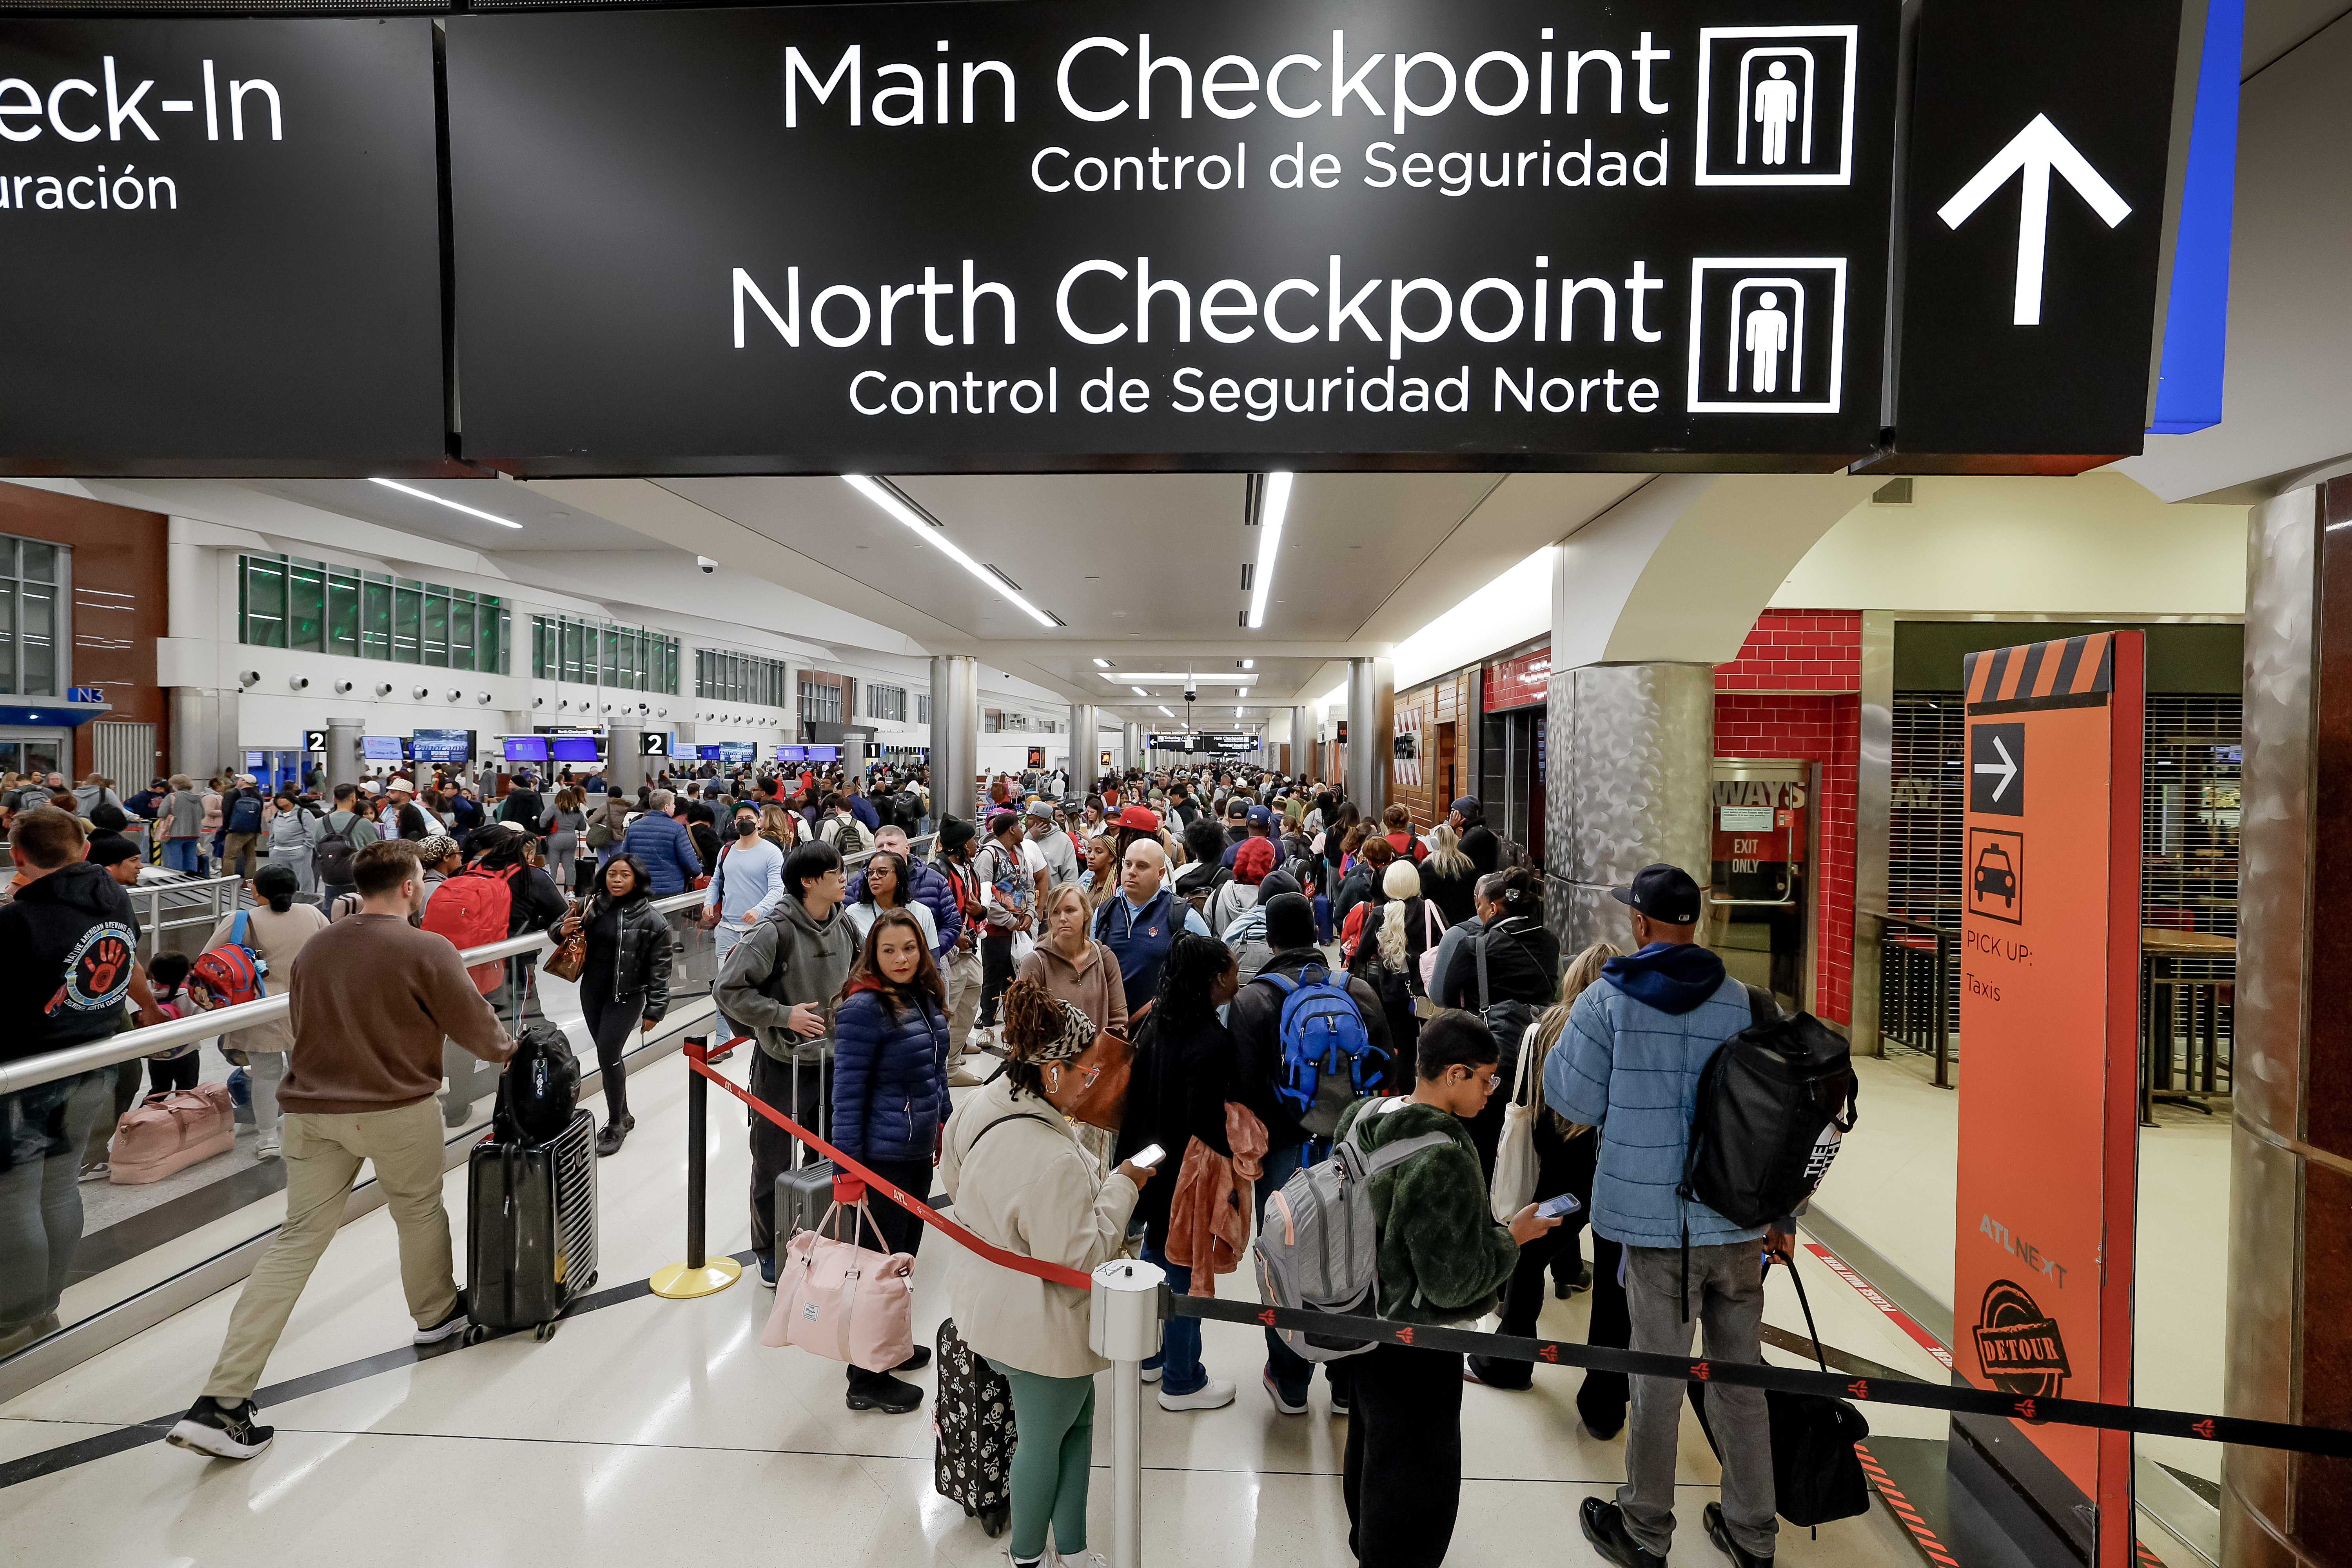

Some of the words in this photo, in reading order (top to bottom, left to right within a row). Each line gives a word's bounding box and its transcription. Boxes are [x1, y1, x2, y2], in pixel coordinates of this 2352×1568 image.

[785, 40, 1016, 128] Main
[1056, 27, 1671, 134] Checkpoint
[0, 56, 282, 142] eck-In
[1031, 142, 1246, 192] Control
[1269, 141, 1342, 190] de
[1363, 138, 1668, 197] Seguridad
[732, 259, 1016, 348] North
[1056, 255, 1664, 360] Checkpoint
[849, 367, 1057, 416] Control
[1080, 367, 1150, 414] de
[1172, 365, 1469, 422] Seguridad
[1494, 367, 1659, 413] Norte
[78, 688, 104, 702] N3
[310, 733, 325, 751] 2
[647, 735, 662, 754] 2
[870, 744, 875, 757] 1
[1713, 781, 1805, 808] WAYS
[1734, 839, 1759, 854] EXIT
[1732, 858, 1760, 873] ONLY
[64, 942, 83, 964] NATIVE
[80, 923, 104, 944] AMERICAN
[105, 921, 127, 931] BREWING
[1967, 930, 2001, 957] PICK
[2007, 941, 2032, 966] UP:
[105, 988, 129, 1006] CAROLINA
[1966, 973, 2000, 1002] Taxis
[724, 1080, 733, 1093] ATL
[1803, 1146, 1829, 1178] THE
[1807, 1143, 1840, 1198] ORTH
[893, 1189, 908, 1207] ATL
[1818, 1256, 1848, 1271] HERE
[1837, 1271, 1869, 1288] WAIT
[1858, 1288, 1898, 1312] PLEASE
[1983, 1337, 2060, 1361] DETOUR
